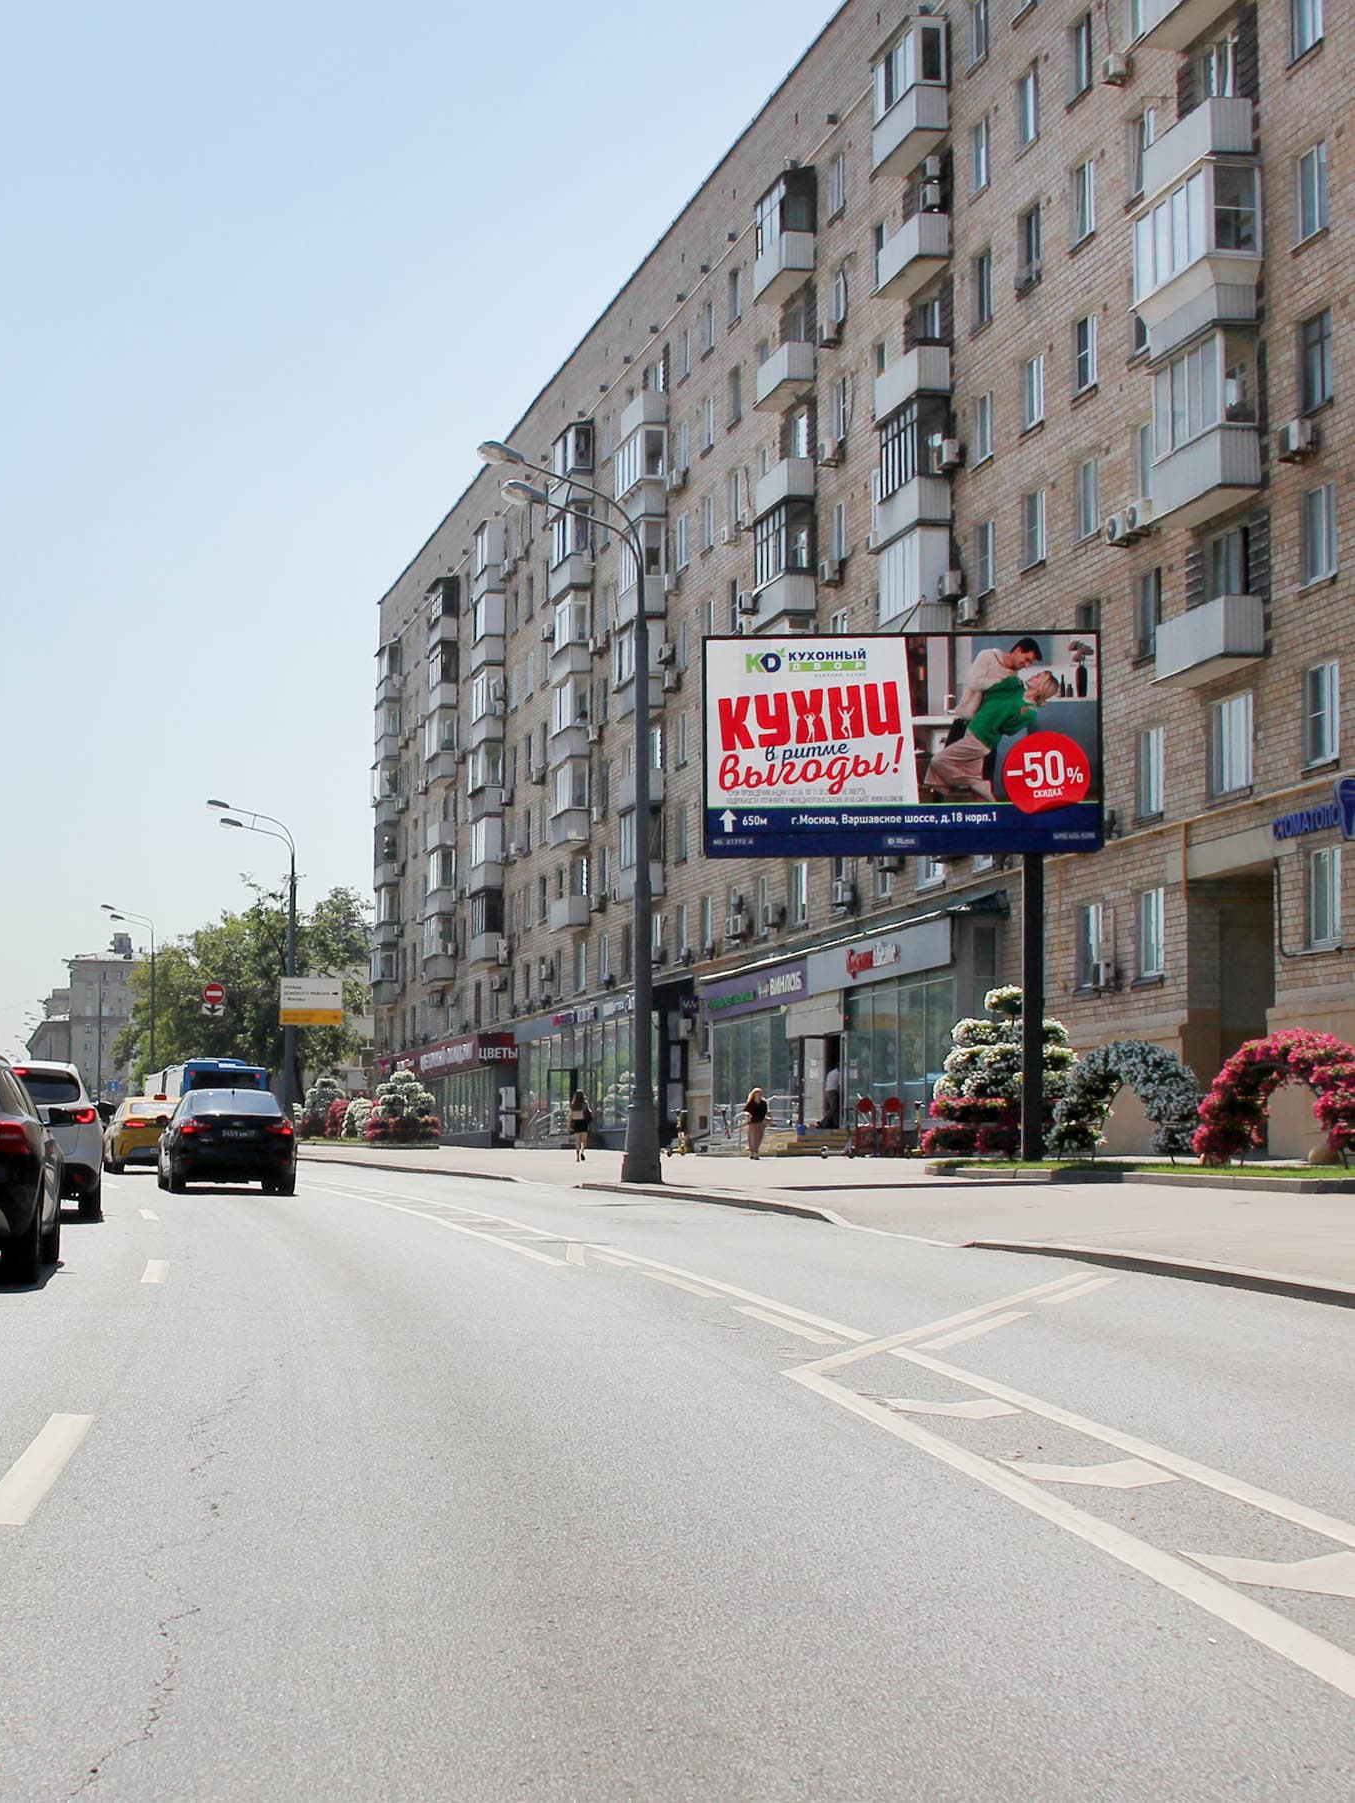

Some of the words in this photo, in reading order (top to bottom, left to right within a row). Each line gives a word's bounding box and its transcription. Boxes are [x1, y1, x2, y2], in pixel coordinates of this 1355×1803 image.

[788, 648, 867, 661] КУХОННЫЙ
[792, 661, 864, 672] ДВОР
[765, 745, 777, 762] в
[780, 743, 851, 768] ритме
[742, 815, 768, 826] 650м
[841, 813, 902, 828] Варшавское
[904, 814, 939, 825] шоссе,
[940, 812, 963, 824] д.18
[965, 811, 997, 825] корп.1
[479, 1046, 519, 1061] ЦВЕТЫ
